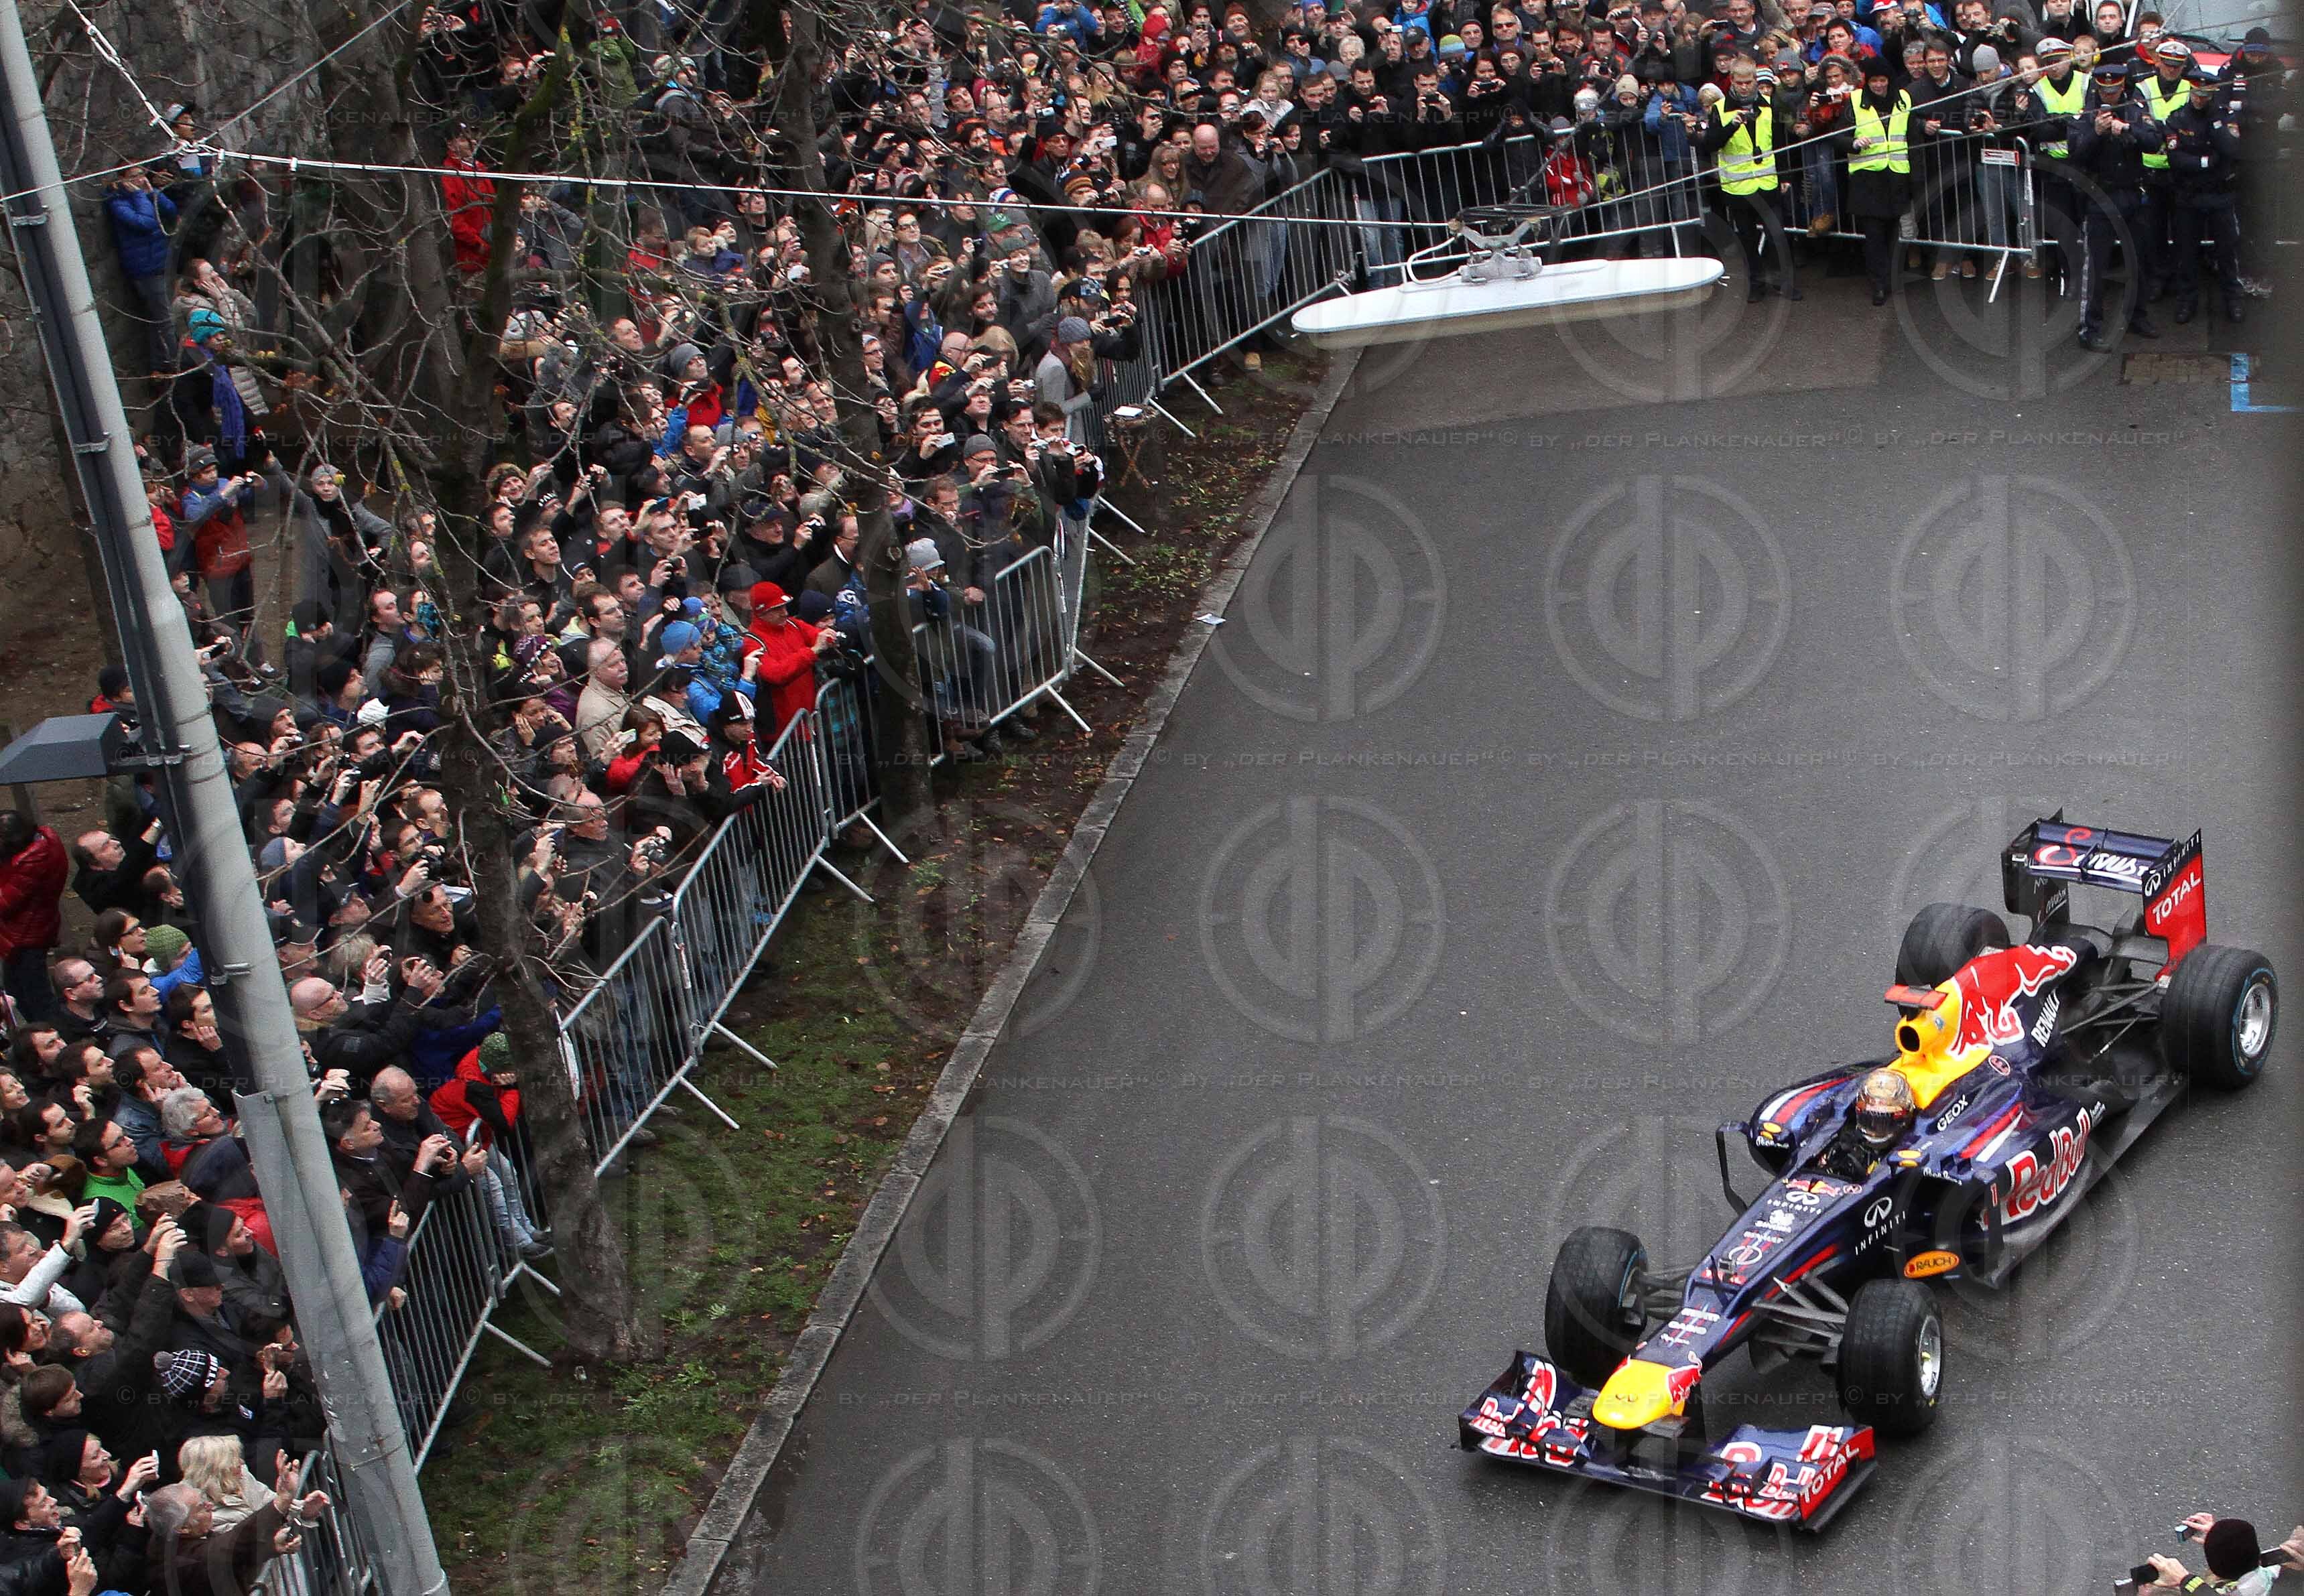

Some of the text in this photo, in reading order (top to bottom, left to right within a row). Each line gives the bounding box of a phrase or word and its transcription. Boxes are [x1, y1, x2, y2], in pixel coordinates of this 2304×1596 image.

[2153, 871, 2201, 925] TOTAL
[1937, 1094, 1969, 1132] GEOX
[1855, 1211, 1906, 1256] INFINITI
[1800, 1444, 1860, 1504] TOTAL
